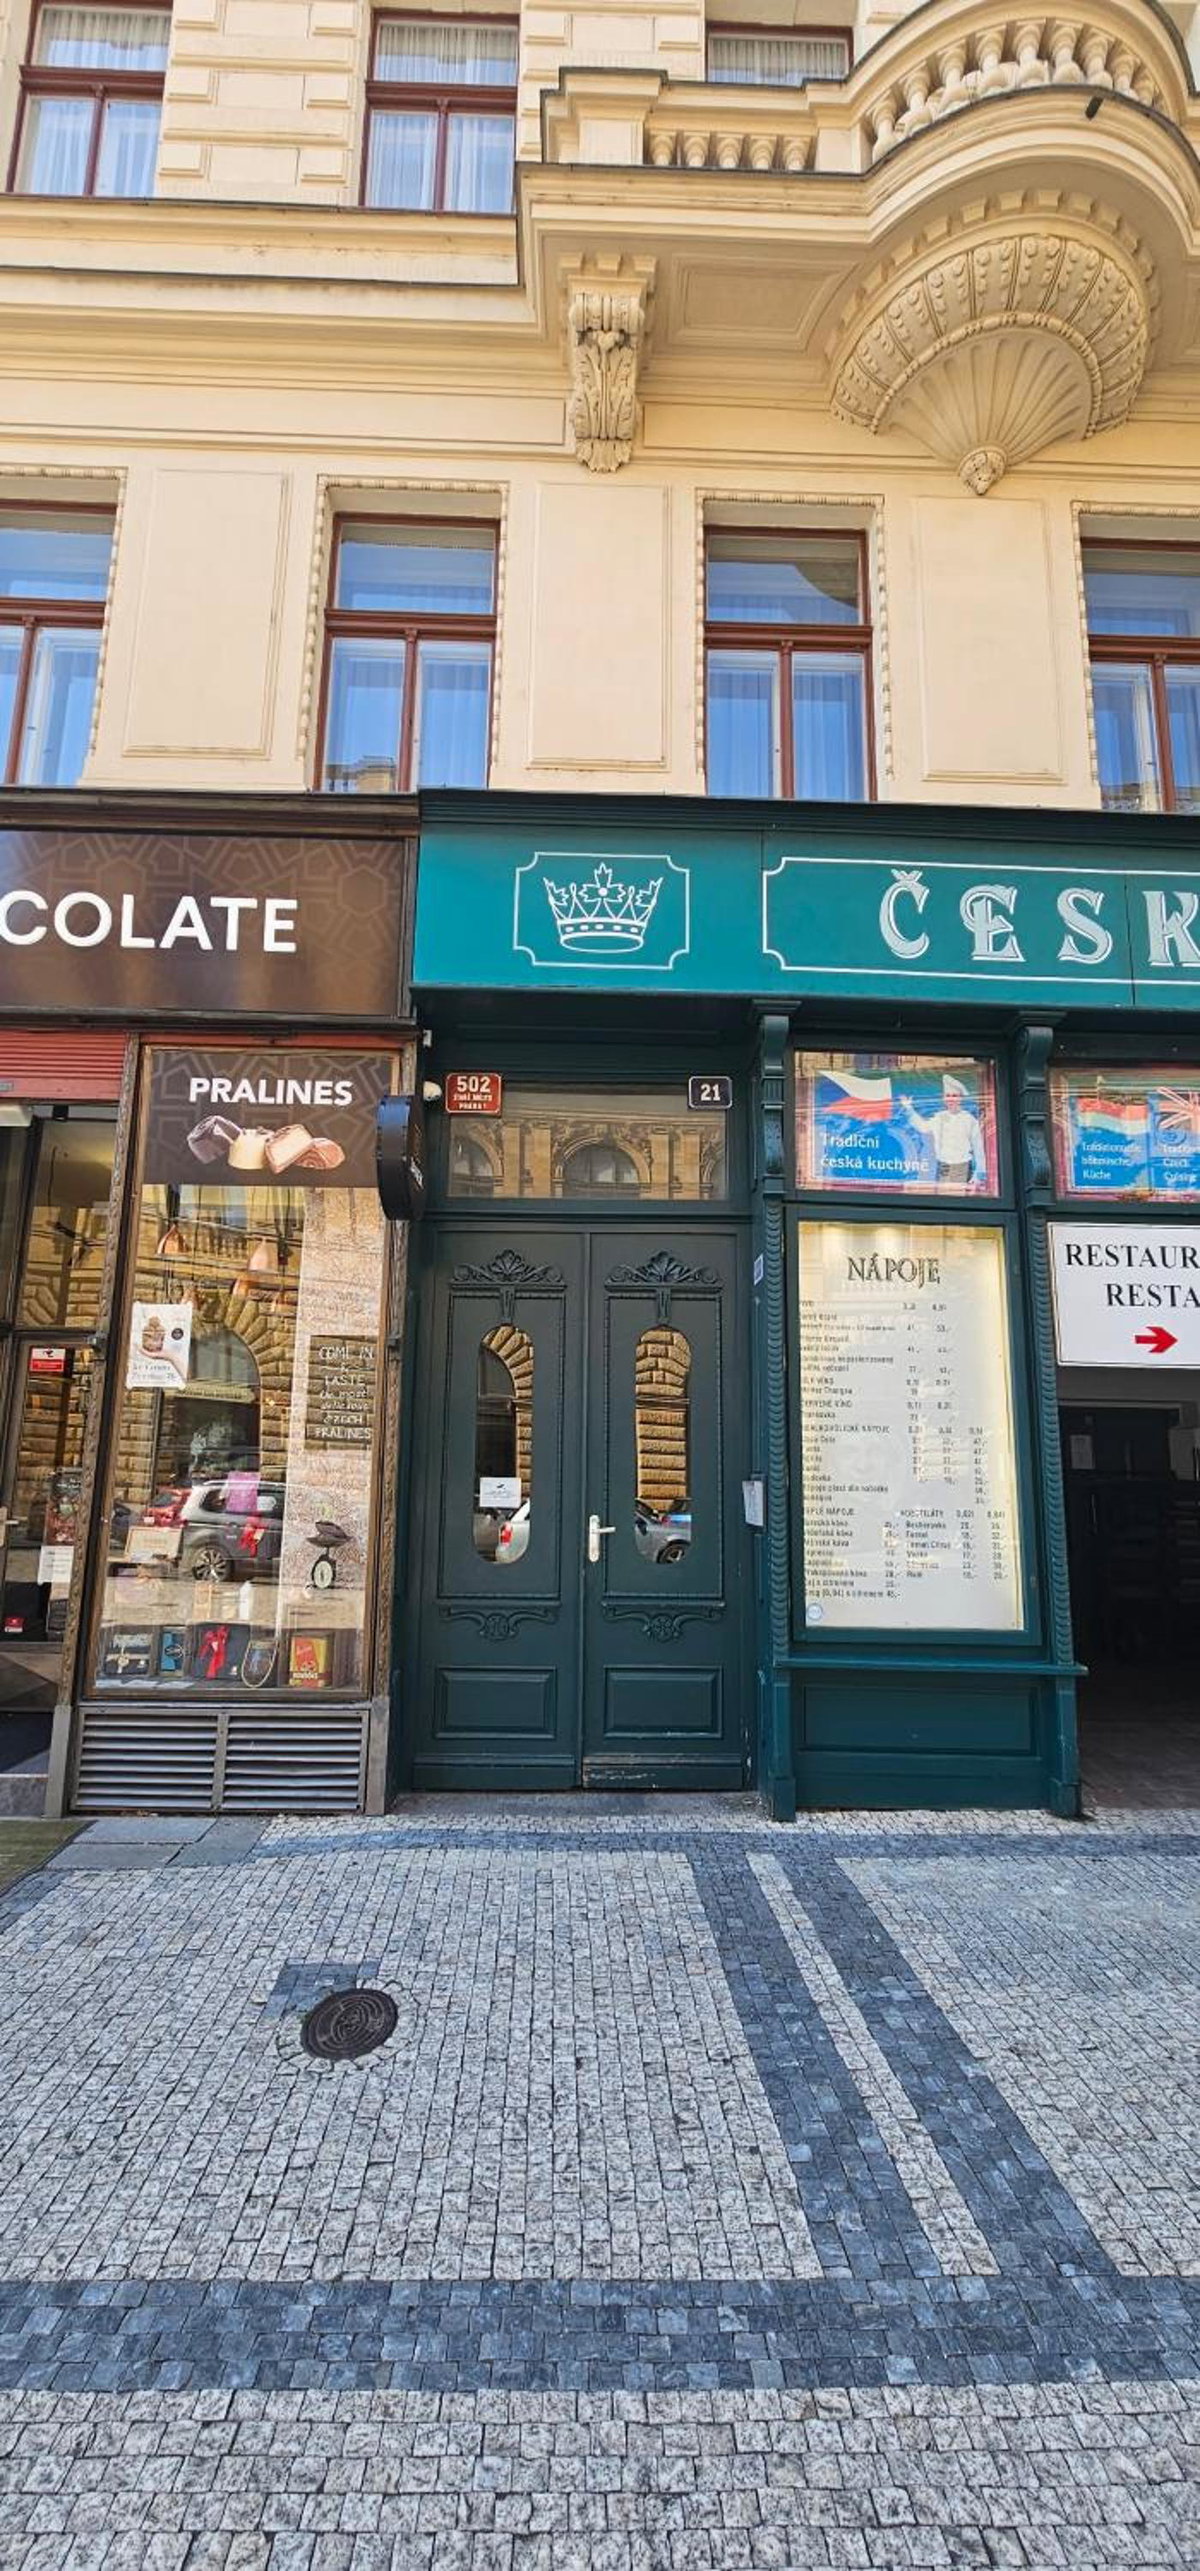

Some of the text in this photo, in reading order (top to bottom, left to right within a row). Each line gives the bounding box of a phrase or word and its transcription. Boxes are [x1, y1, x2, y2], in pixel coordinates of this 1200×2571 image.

[0, 890, 299, 953] COLATE
[877, 870, 1200, 968] ČESK
[189, 1077, 353, 1106] PRALINES
[457, 1075, 491, 1093] 502
[700, 1084, 721, 1101] 21
[821, 1133, 880, 1149] Tradiční
[820, 1154, 930, 1174] česká kuchyně
[1065, 1243, 1200, 1269] RESTAUR
[847, 1253, 941, 1289] NÁPOJE
[1105, 1283, 1200, 1308] RESTA
[315, 1426, 372, 1440] PRALINES
